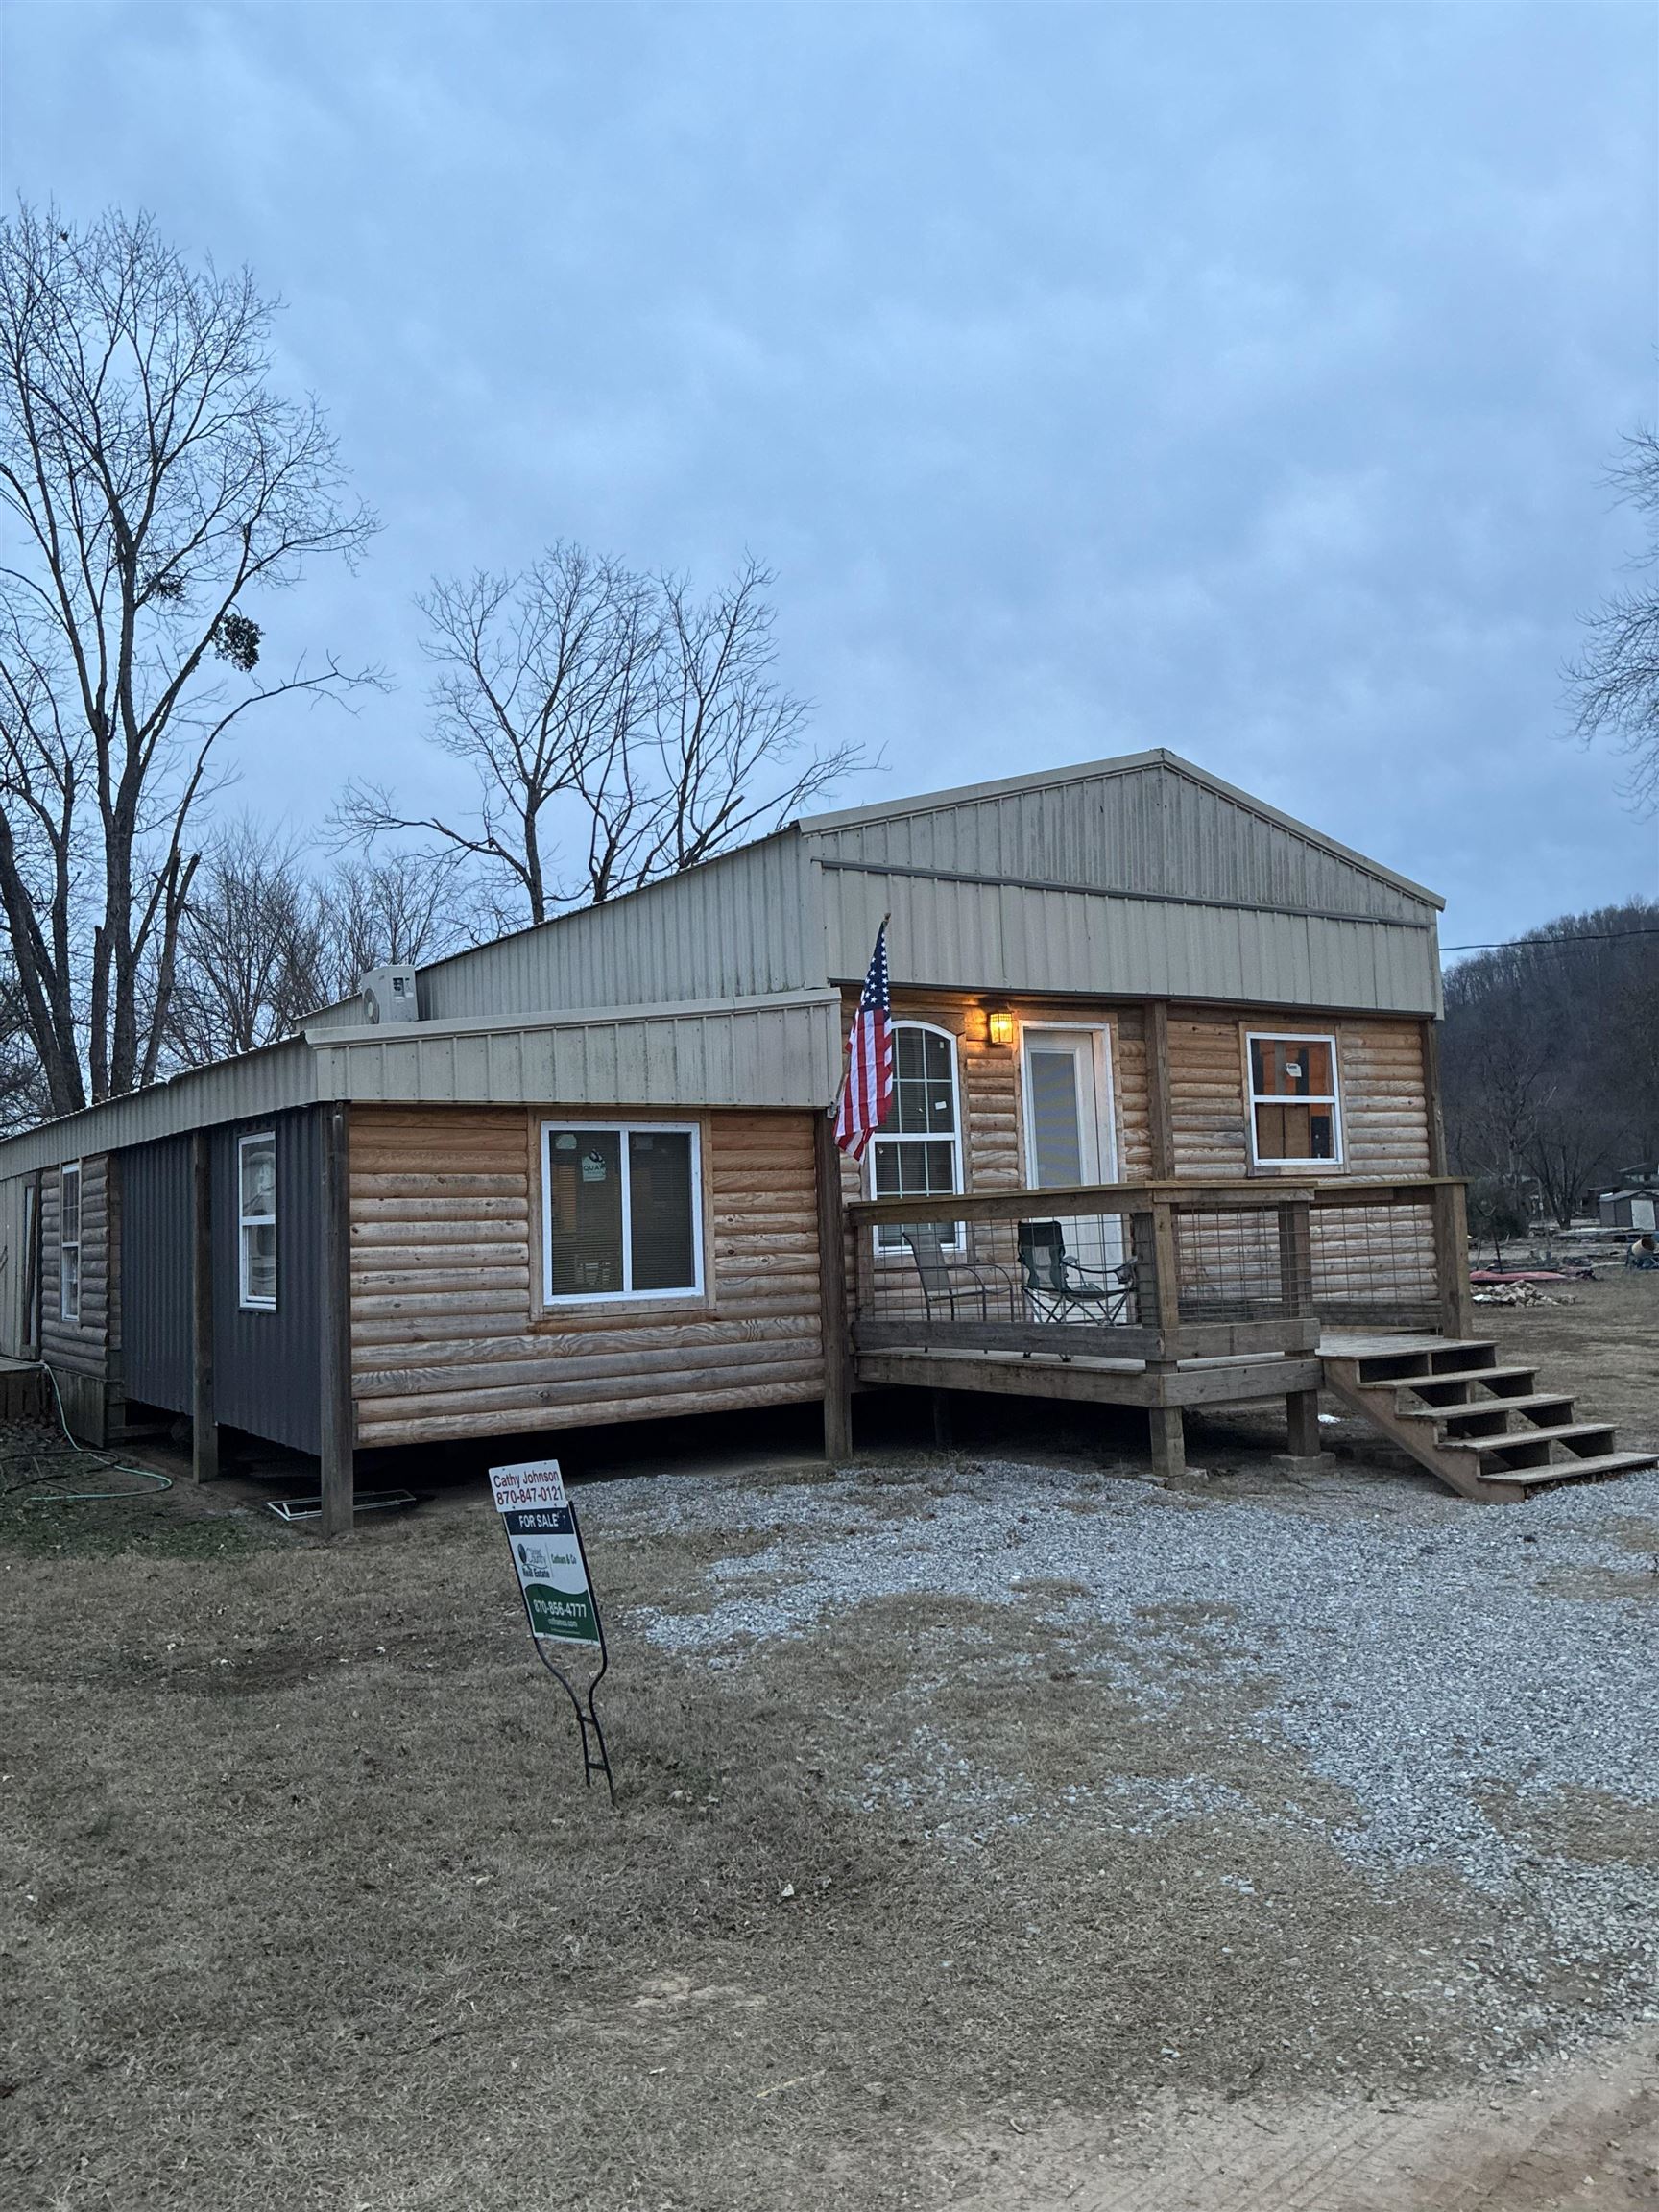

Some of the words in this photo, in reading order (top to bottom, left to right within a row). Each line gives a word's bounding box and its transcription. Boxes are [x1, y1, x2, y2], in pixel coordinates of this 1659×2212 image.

[493, 1473, 520, 1488] Cathy
[523, 1470, 560, 1484] Johnson
[496, 1485, 564, 1505] 870-847-0121
[518, 1514, 536, 1528] FOR
[536, 1513, 559, 1528] SALE
[533, 1599, 587, 1618] 870-856-4777
